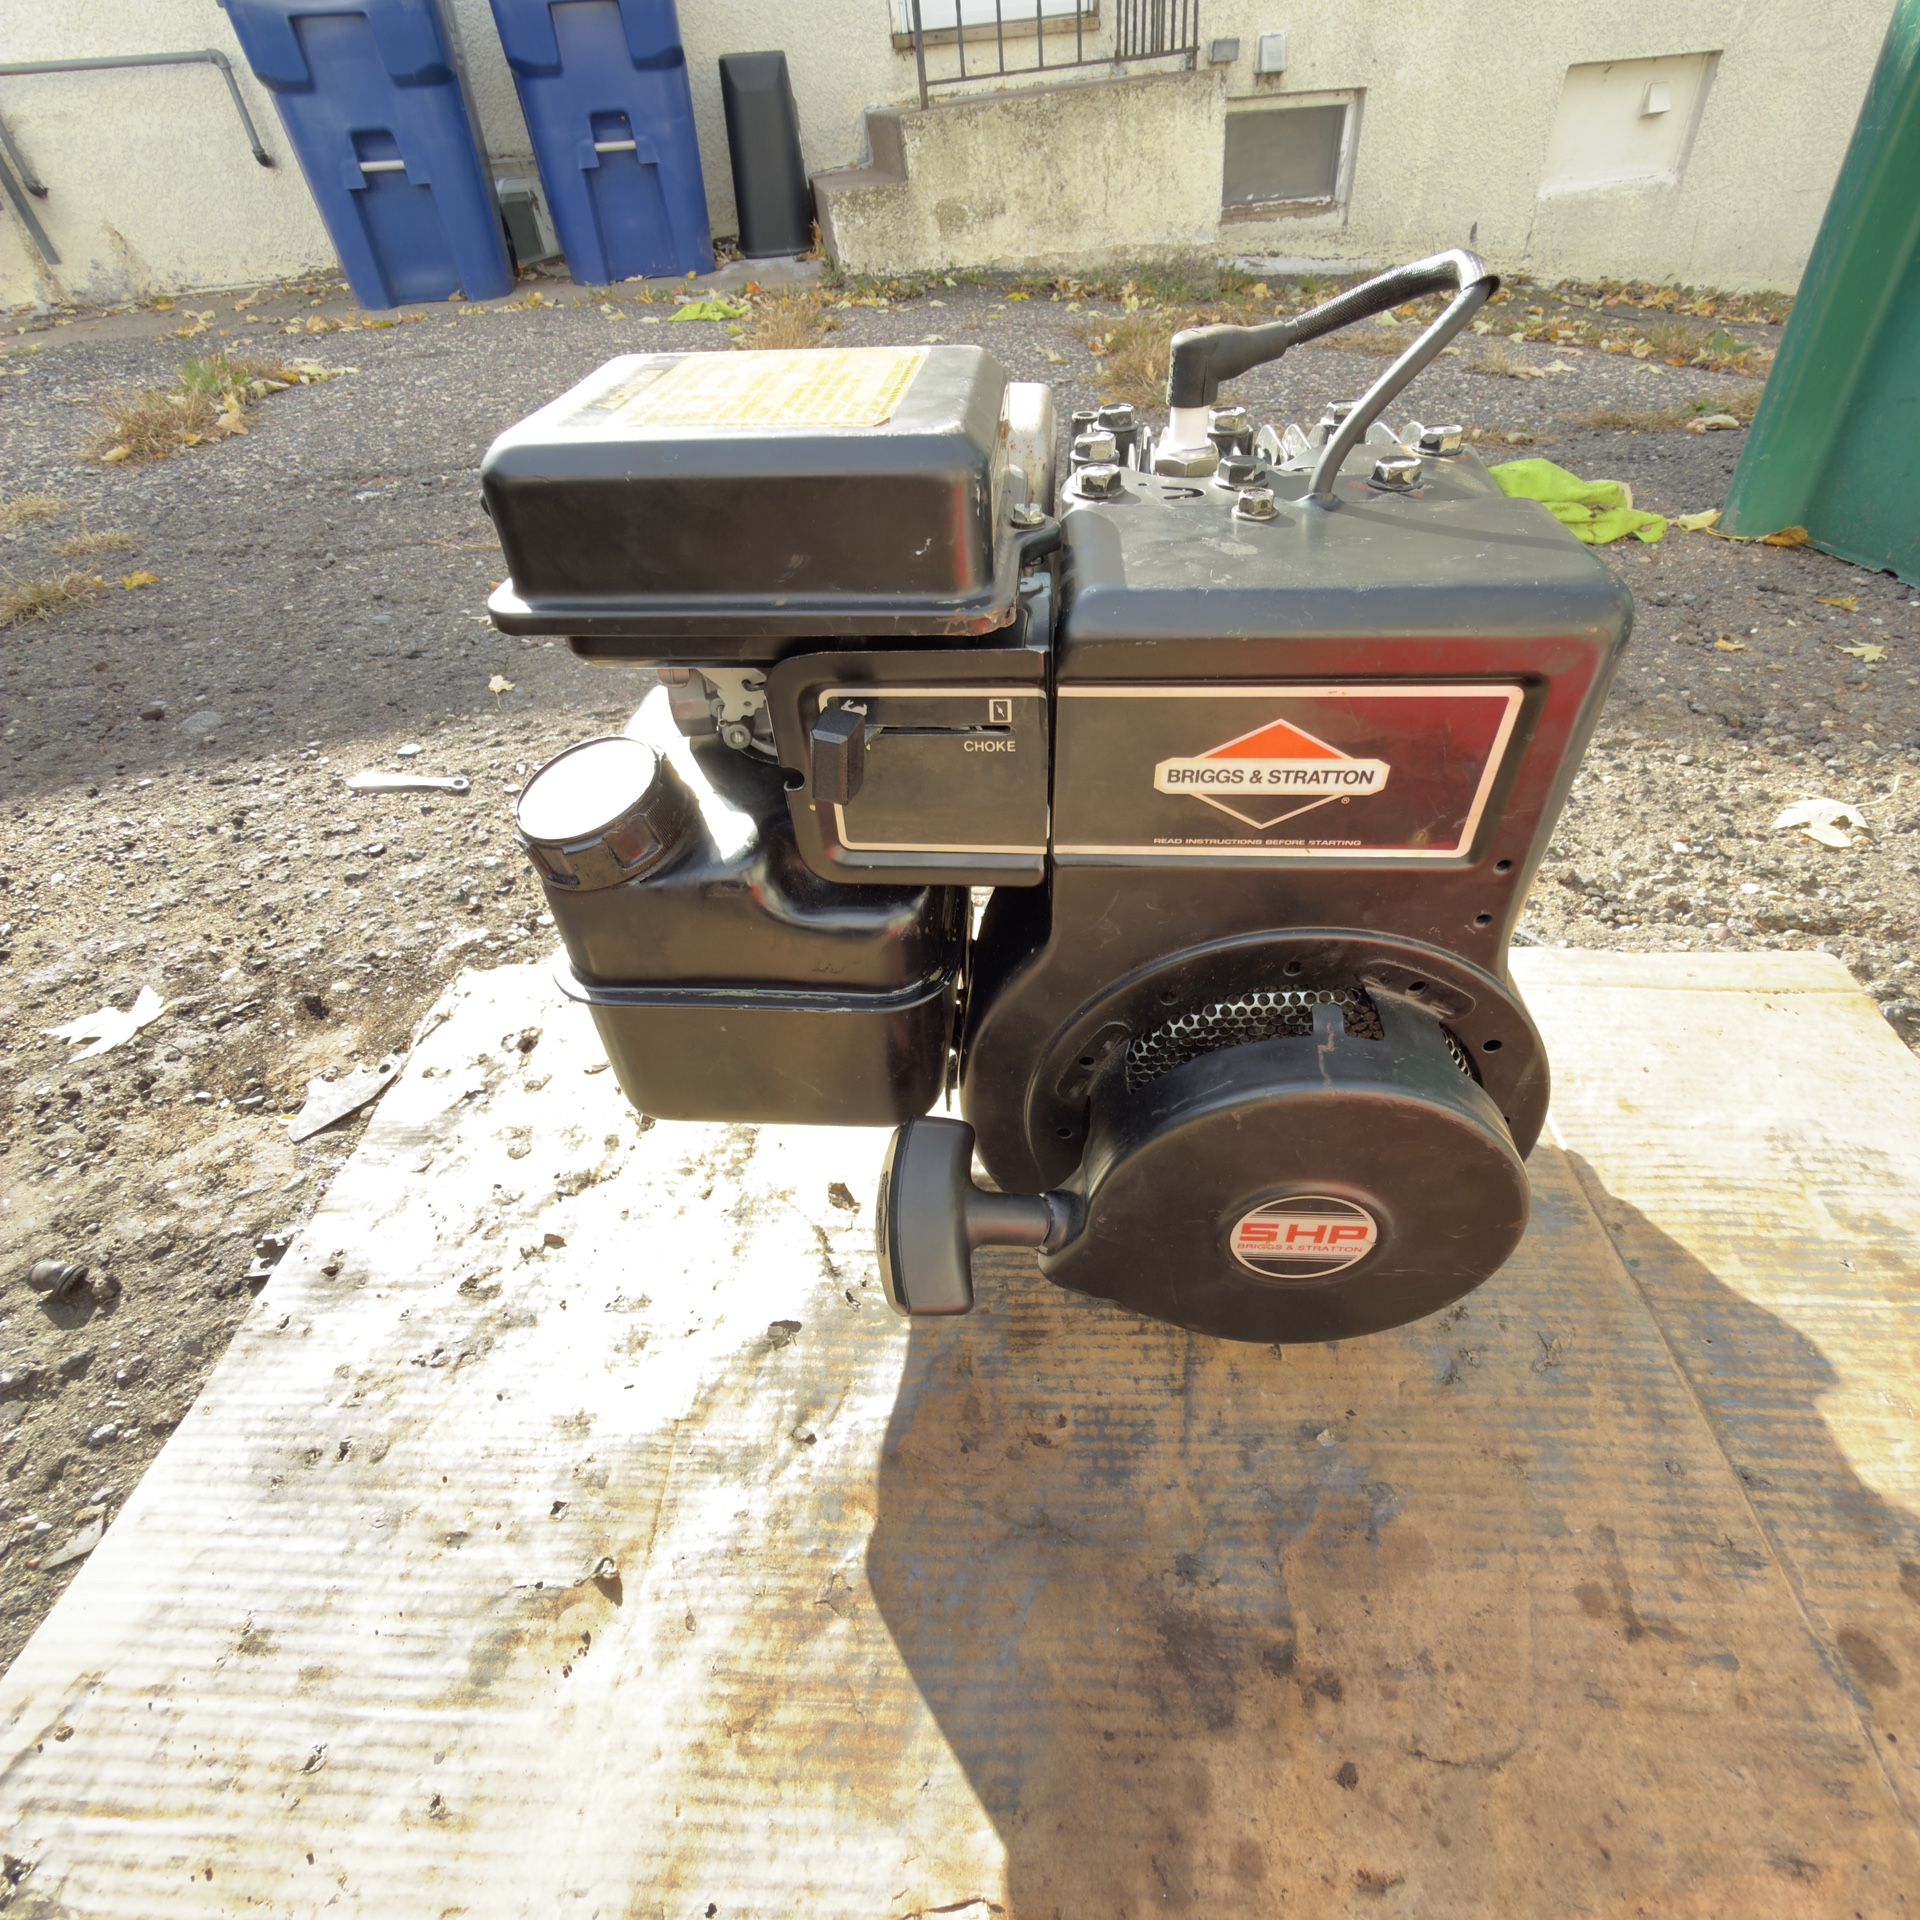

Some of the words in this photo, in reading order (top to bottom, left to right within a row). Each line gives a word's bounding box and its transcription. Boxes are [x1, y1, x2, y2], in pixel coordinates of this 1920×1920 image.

[963, 740, 1016, 752] CHOKE
[1167, 769, 1244, 784] BRIGGS
[1249, 769, 1263, 784] &
[1267, 769, 1375, 785] STRATTON
[1298, 1244, 1363, 1252] STRATTON
